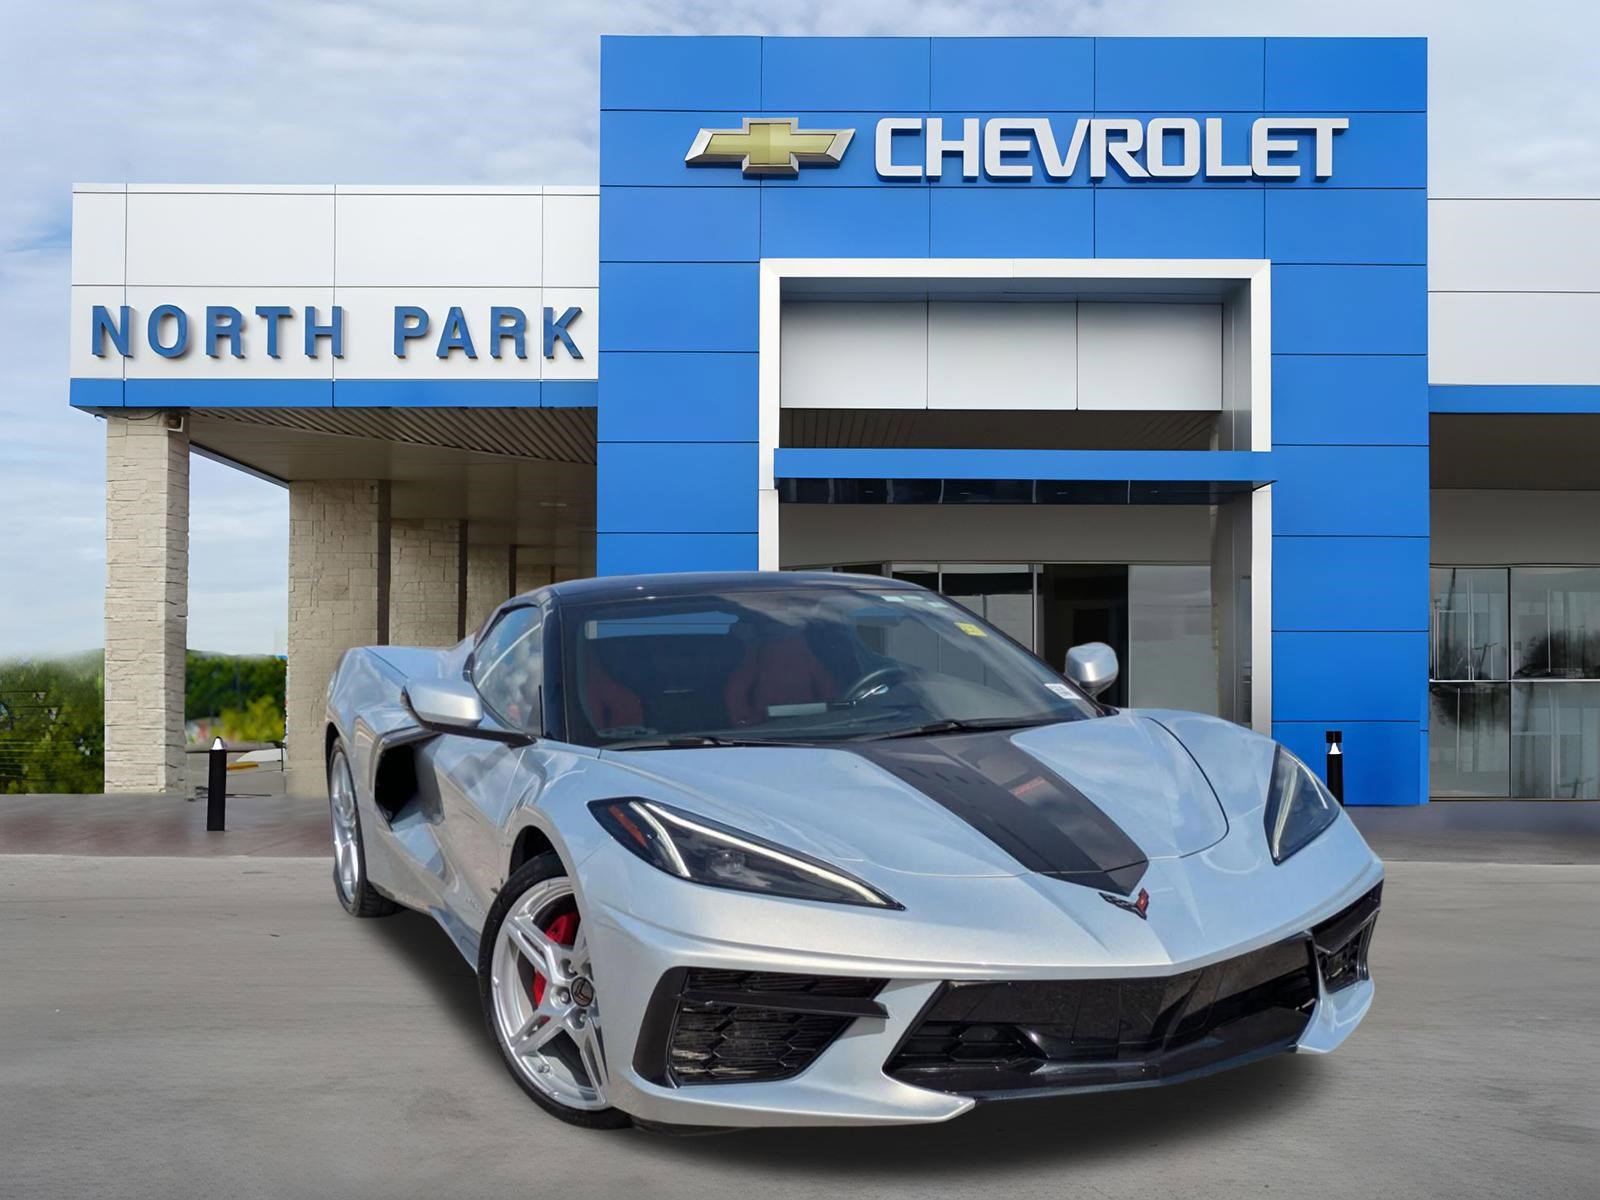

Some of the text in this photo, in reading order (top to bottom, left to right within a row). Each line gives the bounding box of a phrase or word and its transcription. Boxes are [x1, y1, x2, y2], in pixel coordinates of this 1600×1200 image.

[875, 117, 1350, 179] CHEVROLET
[91, 304, 585, 360] NORTH PARK
